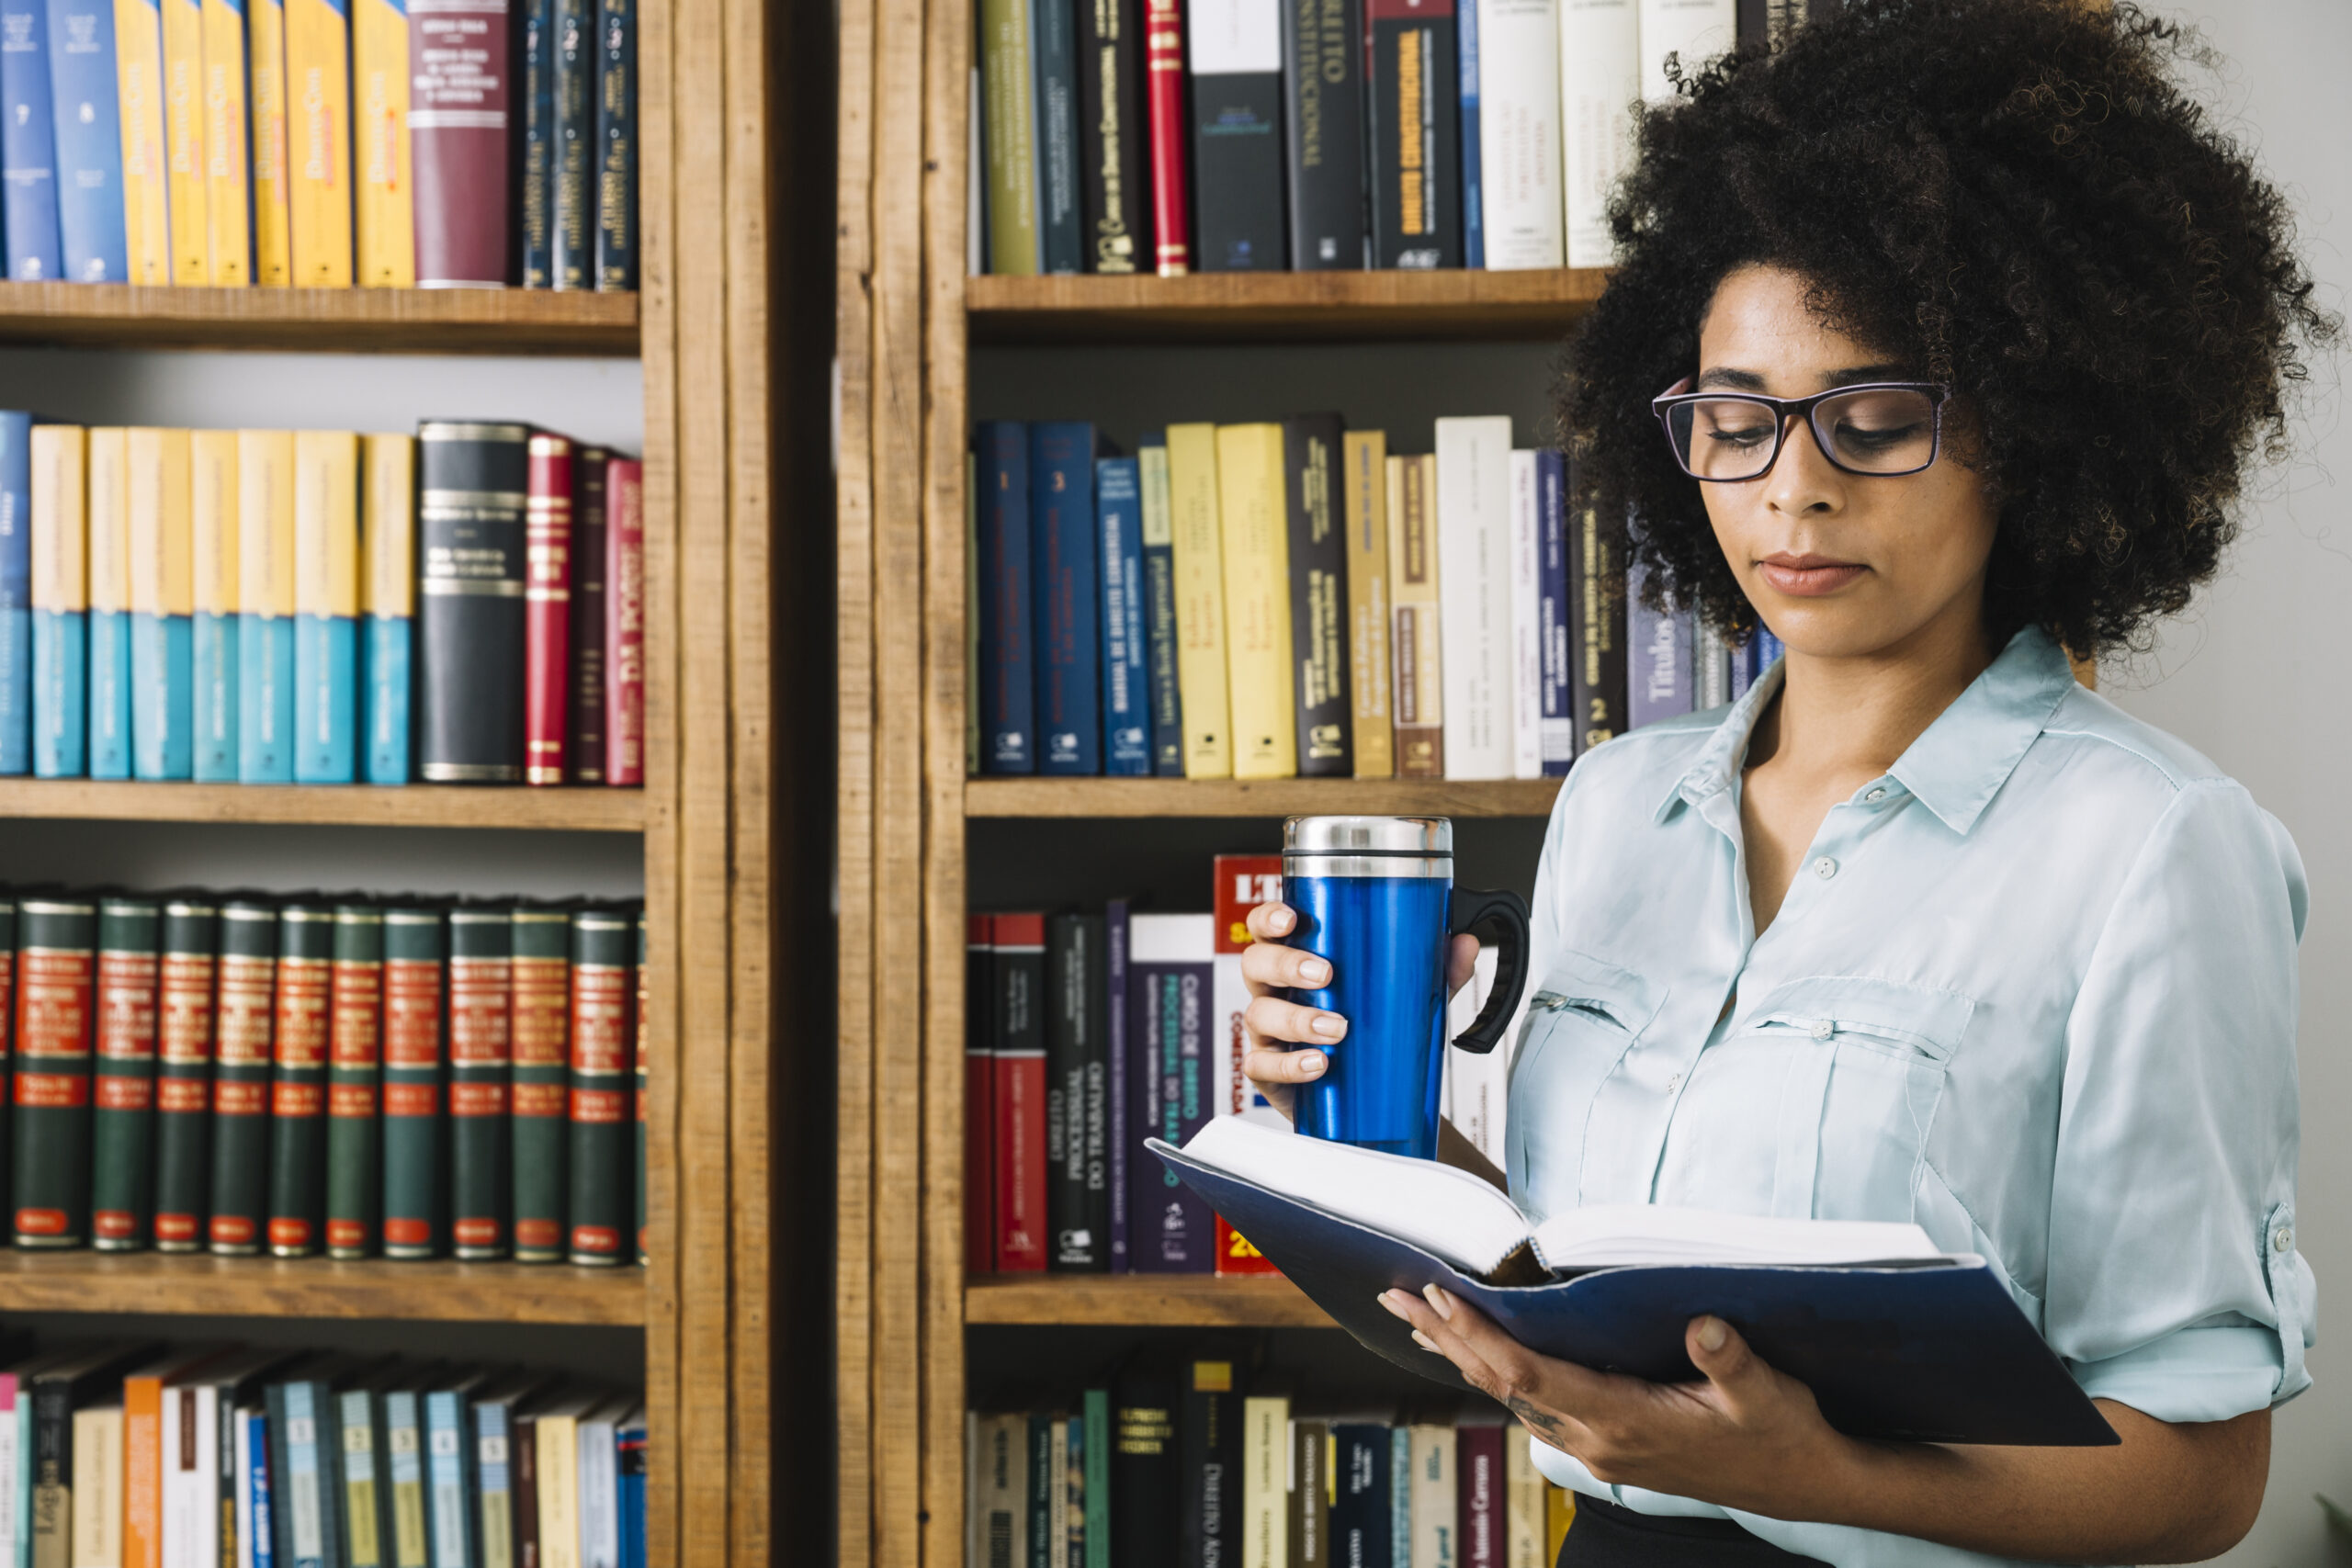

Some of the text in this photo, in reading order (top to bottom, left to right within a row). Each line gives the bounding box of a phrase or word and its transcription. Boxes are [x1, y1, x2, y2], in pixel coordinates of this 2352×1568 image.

[563, 29, 580, 50] 2
[606, 28, 623, 50] 3
[1322, 0, 1346, 83] REITO
[1589, 698, 1608, 721] 2
[1236, 874, 1283, 903] LT
[1163, 975, 1181, 1187] PROCESSUAL DO TRABAO
[1182, 974, 1200, 1120] CURSO DE DIREITO
[1230, 1010, 1243, 1115] COMENTADA
[1049, 1089, 1065, 1161] DIREITO
[1067, 1066, 1084, 1181] PROCESSUAL
[1088, 1061, 1103, 1190] DO TRABALHO
